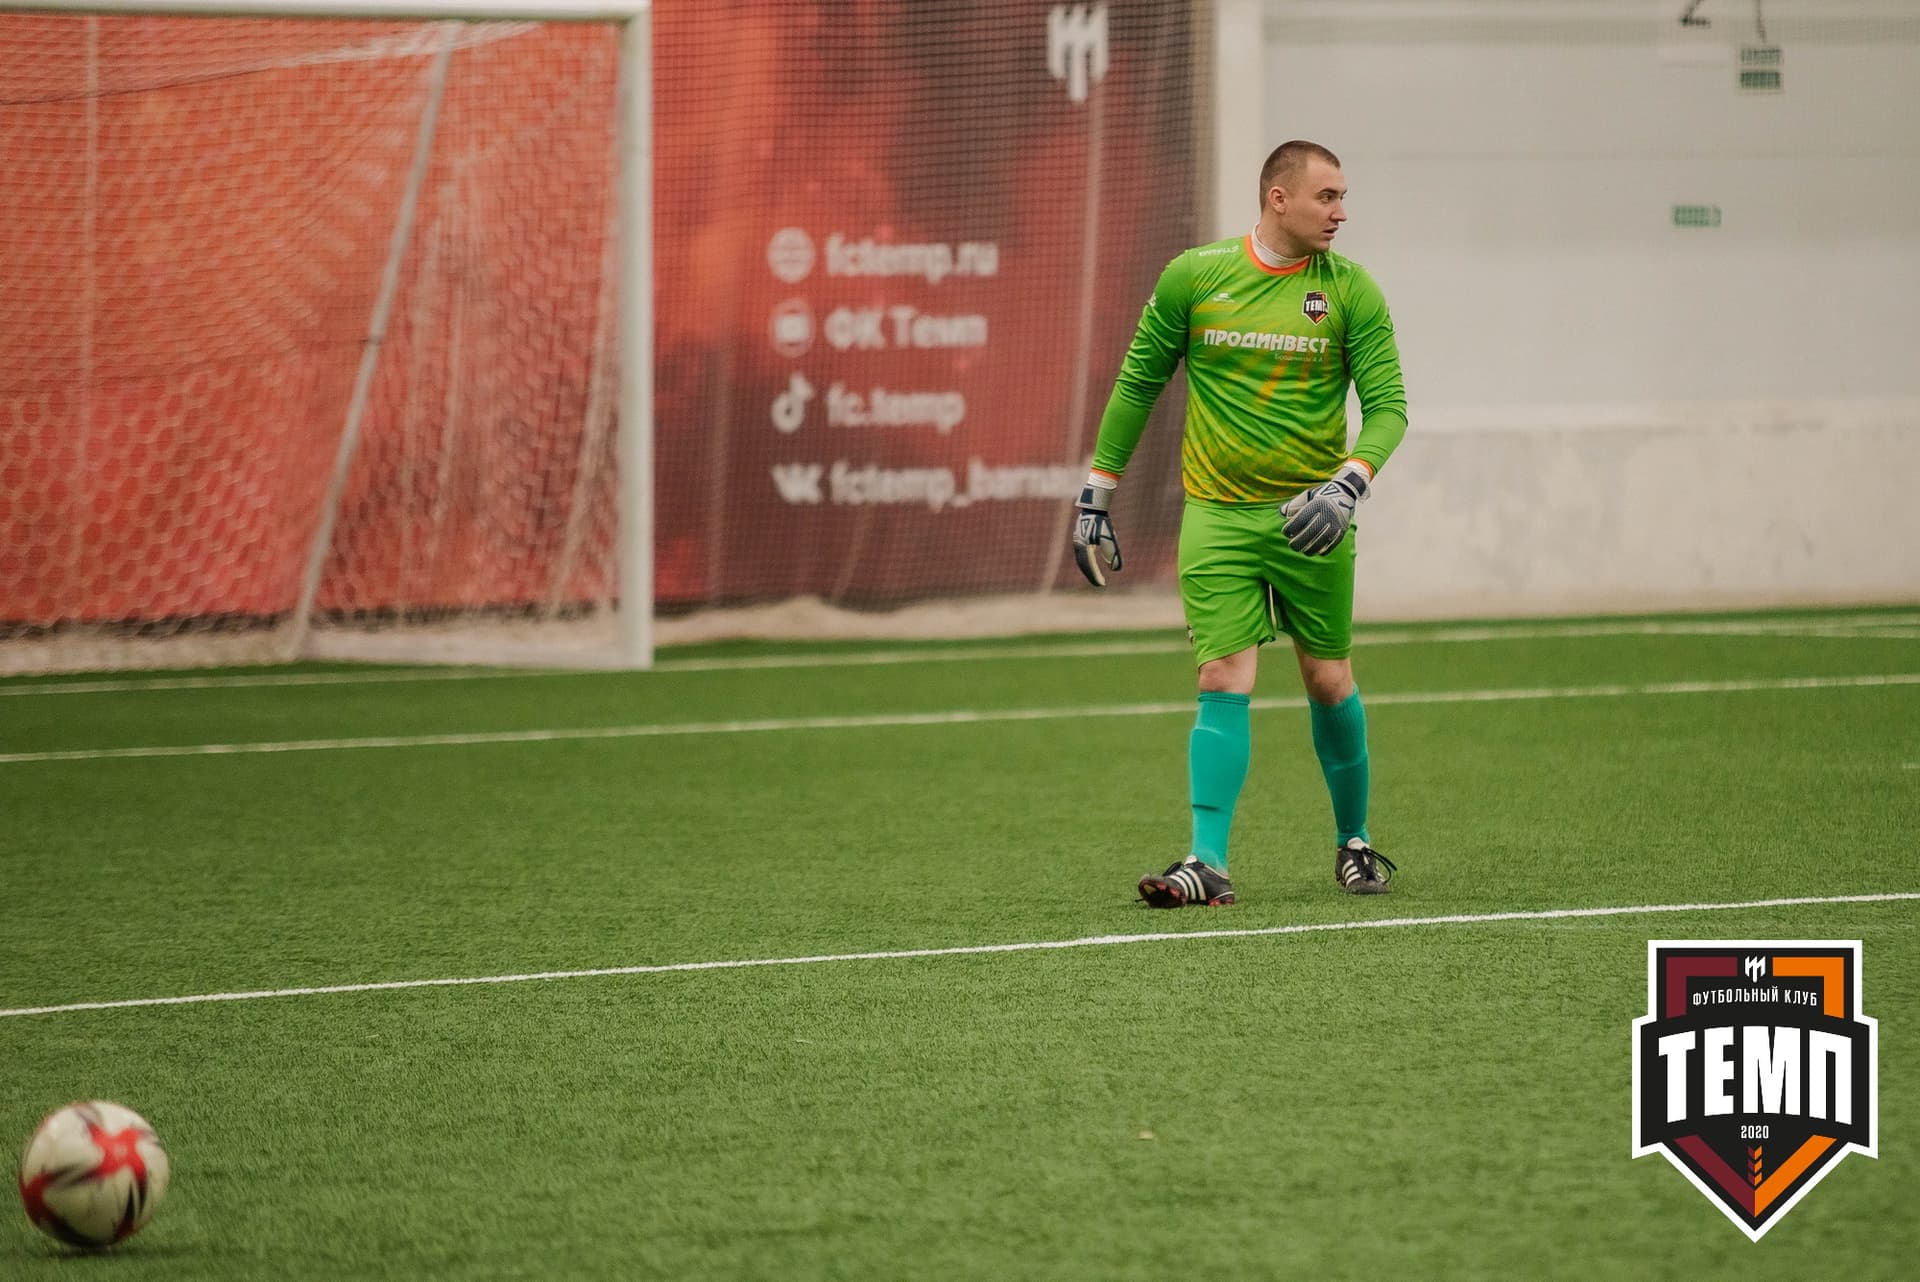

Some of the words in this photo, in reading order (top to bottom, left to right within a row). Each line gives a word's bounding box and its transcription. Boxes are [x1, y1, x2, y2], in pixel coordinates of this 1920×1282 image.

[825, 233, 999, 284] fctemp.ru
[889, 306, 988, 348] Темп
[1203, 328, 1330, 354] ПРОДИНВЕСТ
[826, 384, 965, 434] fc.temp
[829, 457, 1095, 513] fctemp_barna
